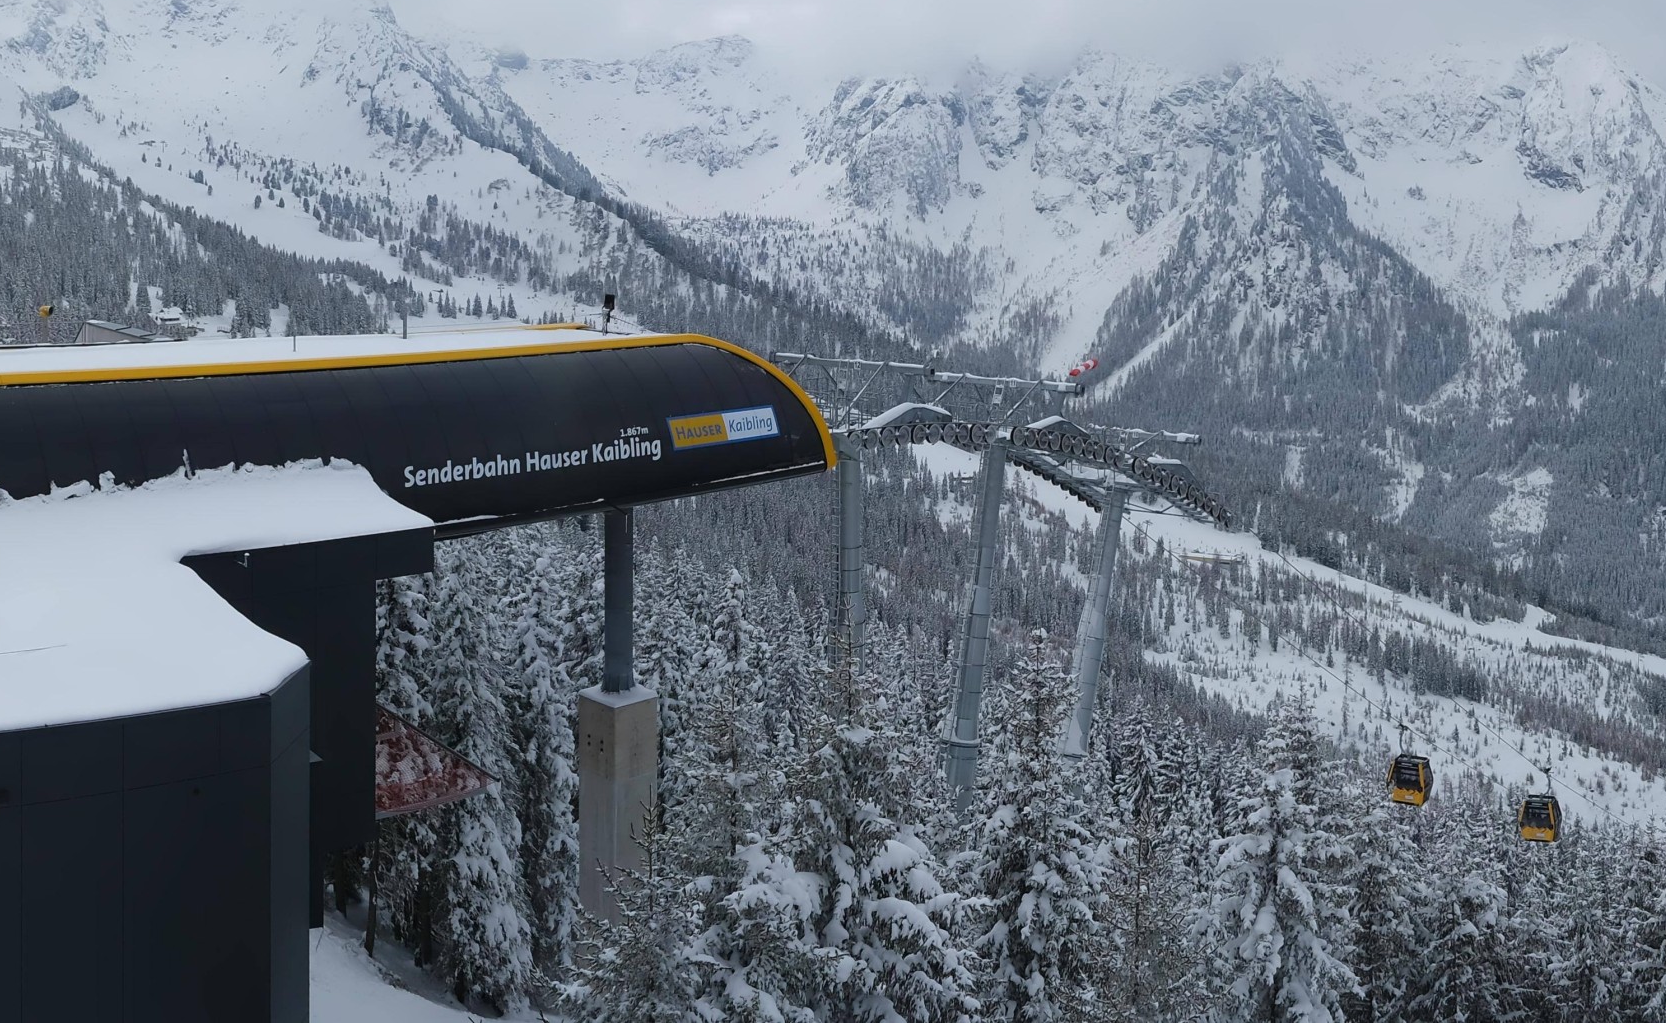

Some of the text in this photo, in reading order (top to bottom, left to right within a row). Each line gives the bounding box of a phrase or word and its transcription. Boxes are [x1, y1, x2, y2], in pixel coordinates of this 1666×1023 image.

[619, 426, 649, 437] 1.867m
[675, 416, 773, 440] HAUSER Kaibling
[403, 437, 662, 488] Senderbahn Hauser Kaibling
